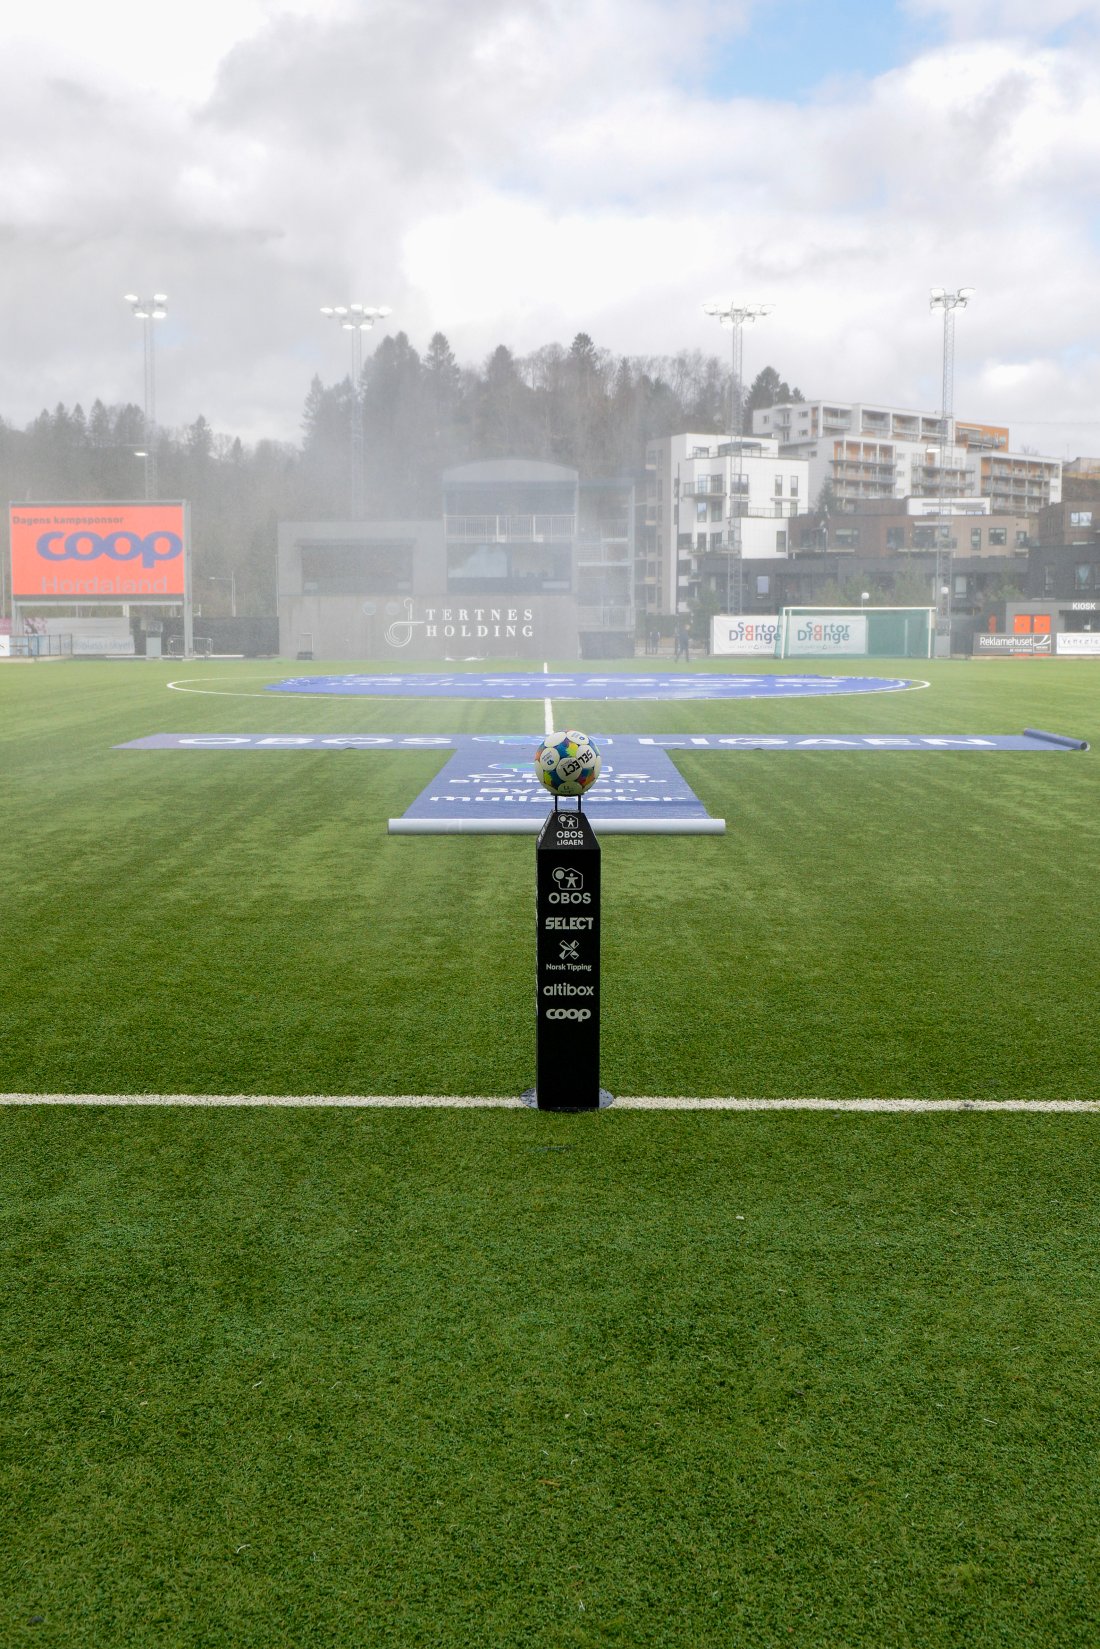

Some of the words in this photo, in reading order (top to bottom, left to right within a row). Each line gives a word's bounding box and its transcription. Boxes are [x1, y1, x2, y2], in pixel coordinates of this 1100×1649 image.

[12, 515, 51, 525] Dagens
[53, 515, 124, 525] kampsponsor
[36, 530, 183, 569] coop
[41, 575, 168, 593] Hordaland
[1072, 602, 1096, 610] KIOSK
[426, 608, 534, 621] TERTNES
[426, 624, 534, 637] HOLDING
[737, 621, 782, 634] Sartor
[806, 621, 850, 634] Sartor
[979, 636, 1033, 646] Reklamehuset
[176, 737, 452, 745] OBOS
[637, 737, 998, 746] LIGAEN
[563, 749, 593, 776] SELECT
[556, 831, 584, 839] OBOS
[548, 892, 592, 905] OBOS
[545, 917, 594, 930] SELECT
[545, 963, 566, 971] Norsk
[567, 963, 592, 971] Tipping
[543, 982, 594, 996] altibox
[545, 1008, 591, 1022] coop
